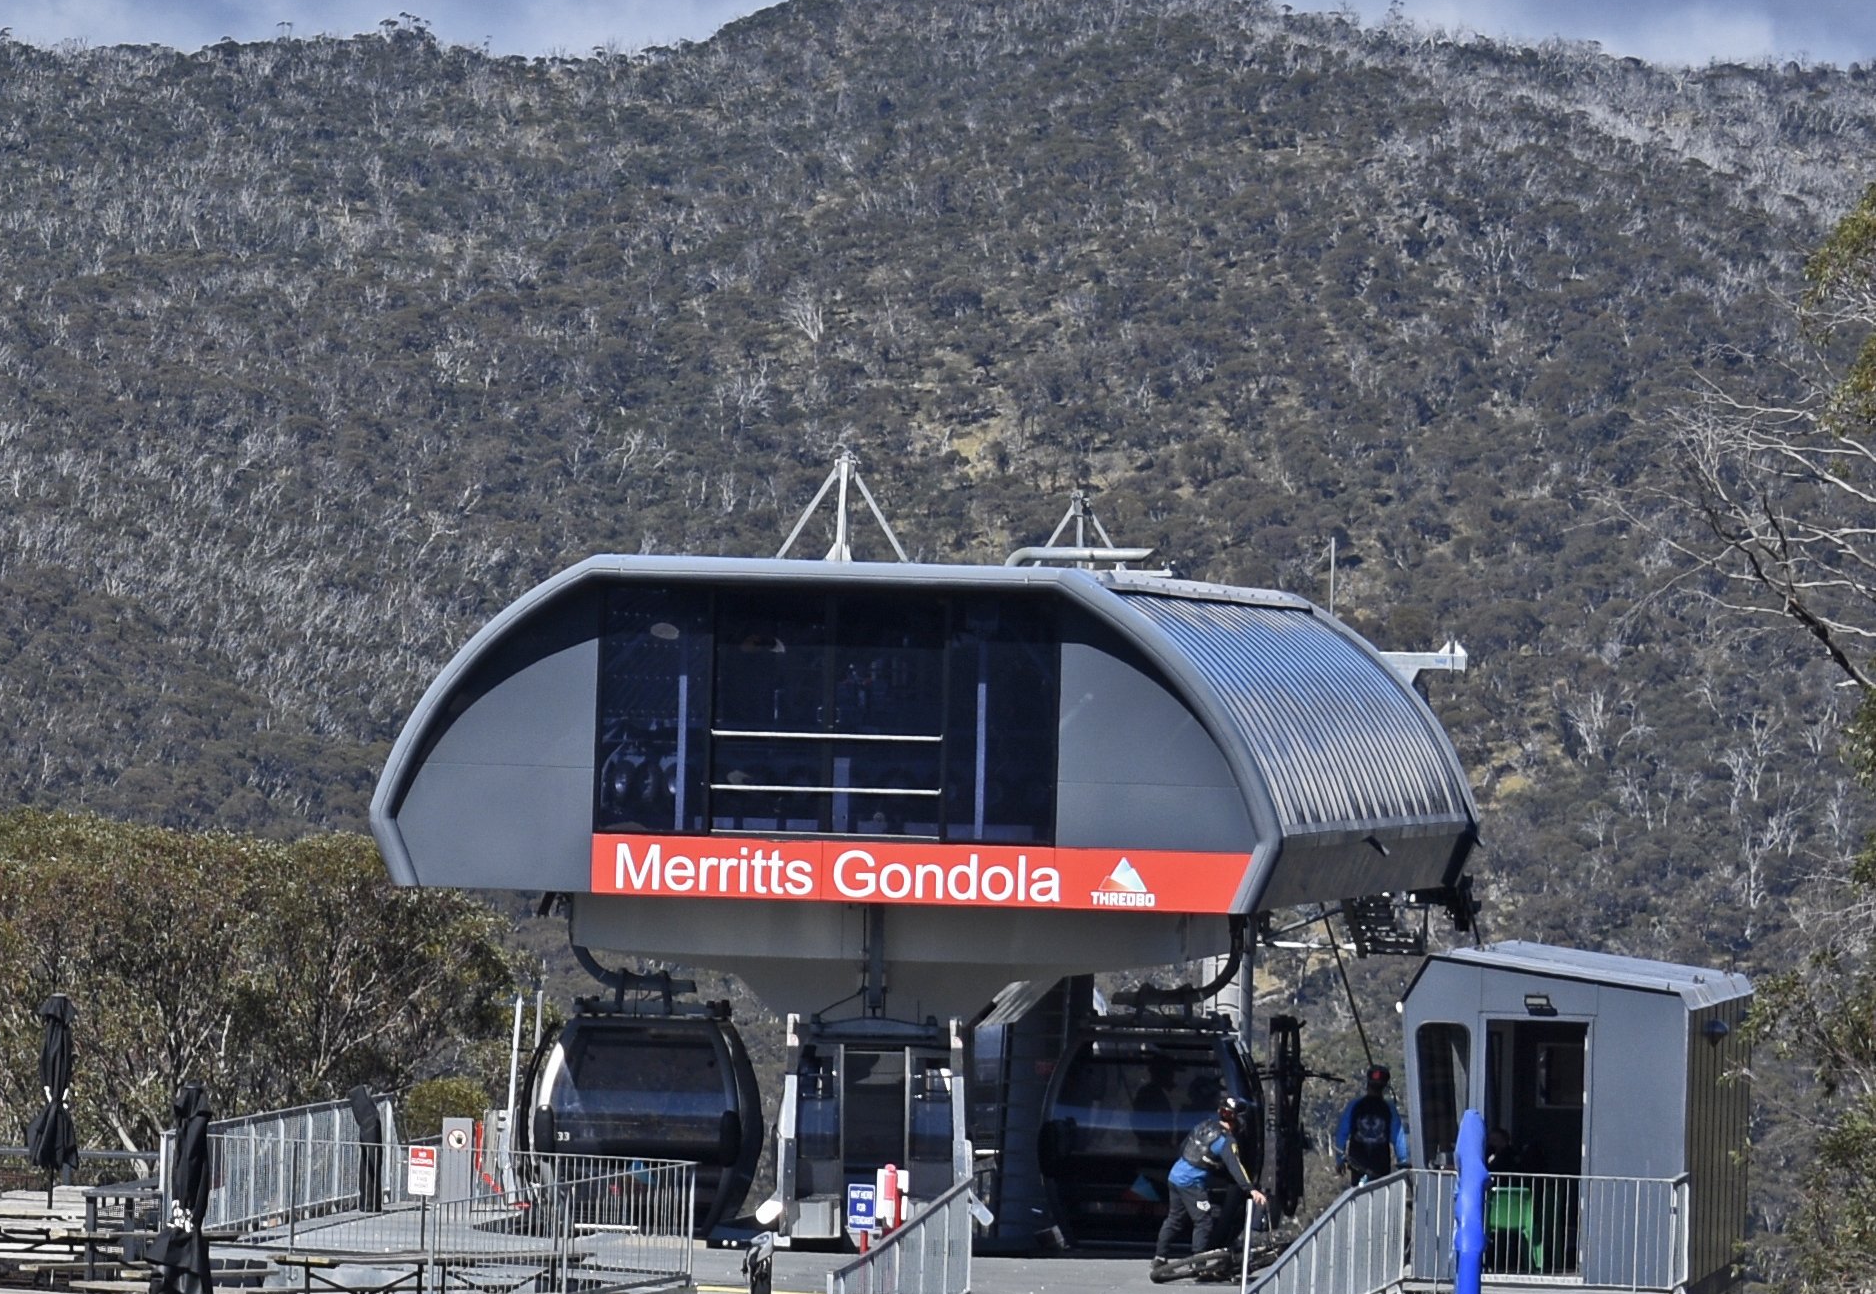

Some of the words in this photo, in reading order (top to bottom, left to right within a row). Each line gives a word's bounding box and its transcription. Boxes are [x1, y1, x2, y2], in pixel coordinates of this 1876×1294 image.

[615, 843, 813, 895] Merritts
[833, 849, 1061, 903] Gondola
[1090, 891, 1156, 907] THREDBO
[557, 1131, 570, 1141] 33
